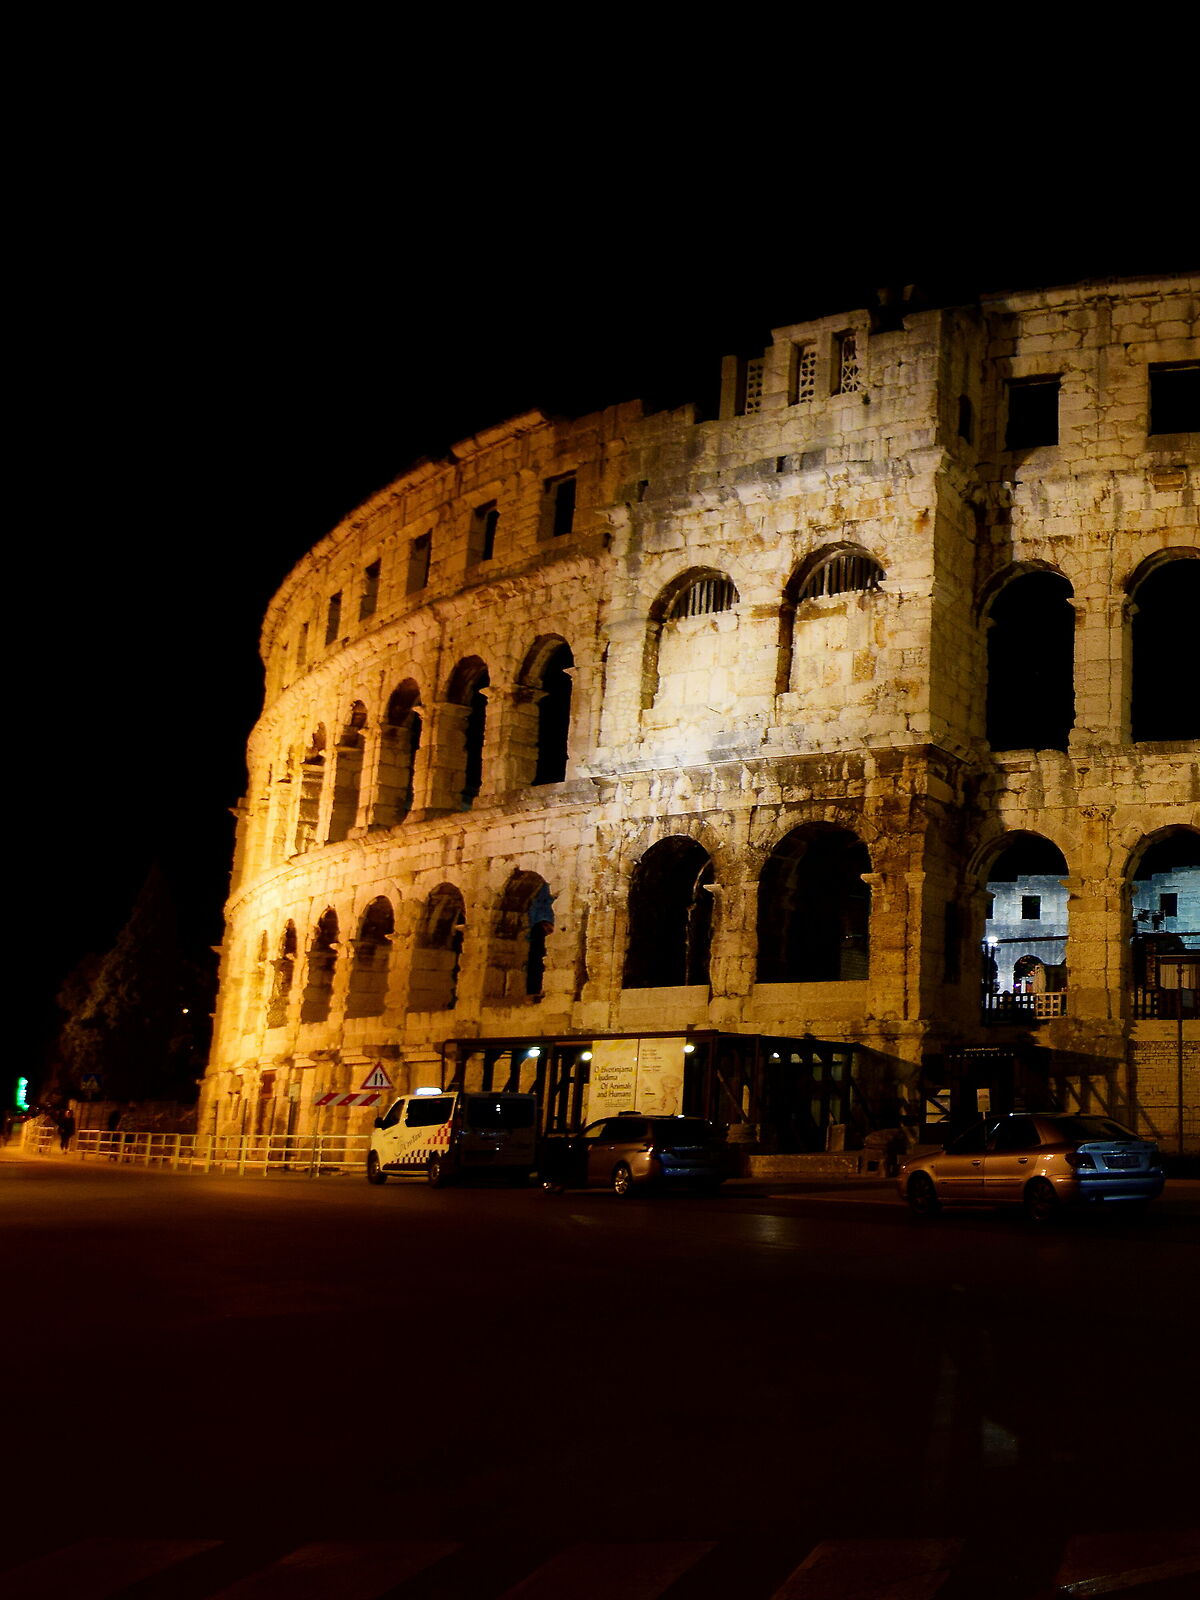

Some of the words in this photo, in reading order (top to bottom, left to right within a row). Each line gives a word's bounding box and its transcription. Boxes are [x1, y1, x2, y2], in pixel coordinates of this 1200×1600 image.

[601, 1082, 609, 1090] Of
[610, 1082, 632, 1090] Animals
[597, 1090, 607, 1098] and
[608, 1089, 631, 1098] Humans
